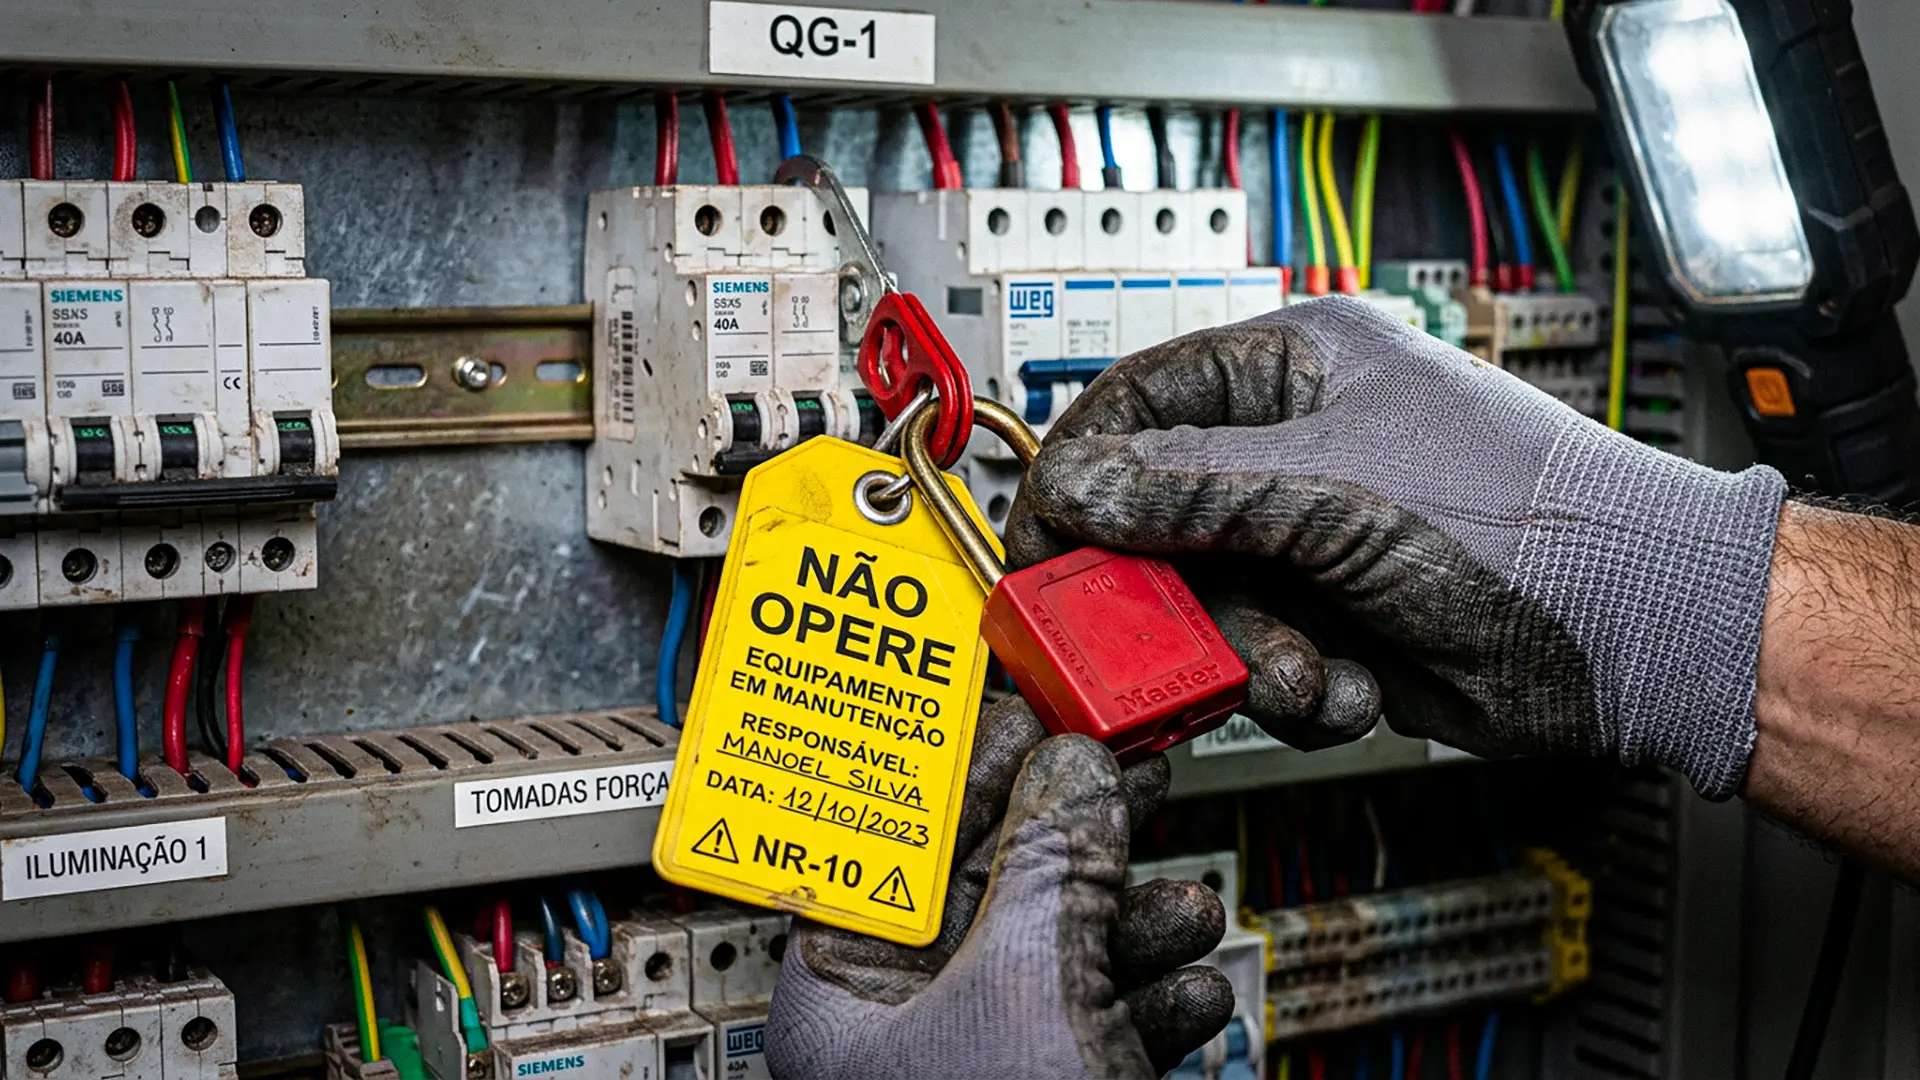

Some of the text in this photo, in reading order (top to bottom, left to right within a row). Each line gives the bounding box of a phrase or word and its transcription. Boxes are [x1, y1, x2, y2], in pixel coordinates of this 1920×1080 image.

[770, 14, 876, 59] QG-1
[50, 289, 123, 303] SIEMENS
[713, 282, 769, 293] SIEMENS
[53, 331, 86, 345] 40A
[713, 318, 740, 330] 40A
[796, 546, 929, 618] NÃO
[751, 592, 956, 686] OPERE
[745, 646, 941, 719] EQUIPAMENTO
[1114, 663, 1221, 715] Master
[730, 670, 945, 748] EM MANUTENÇÃO
[722, 732, 923, 807] MANOEL SILVA
[740, 712, 919, 778] RESPONSÁVEL:
[471, 771, 669, 814] TOMADAS FORÇA
[706, 770, 930, 846] DATA: 12/10/2023
[26, 836, 208, 880] ILUMINAÇÃO 1
[752, 834, 863, 889] NR-10
[517, 1055, 585, 1076] SIEMENS
